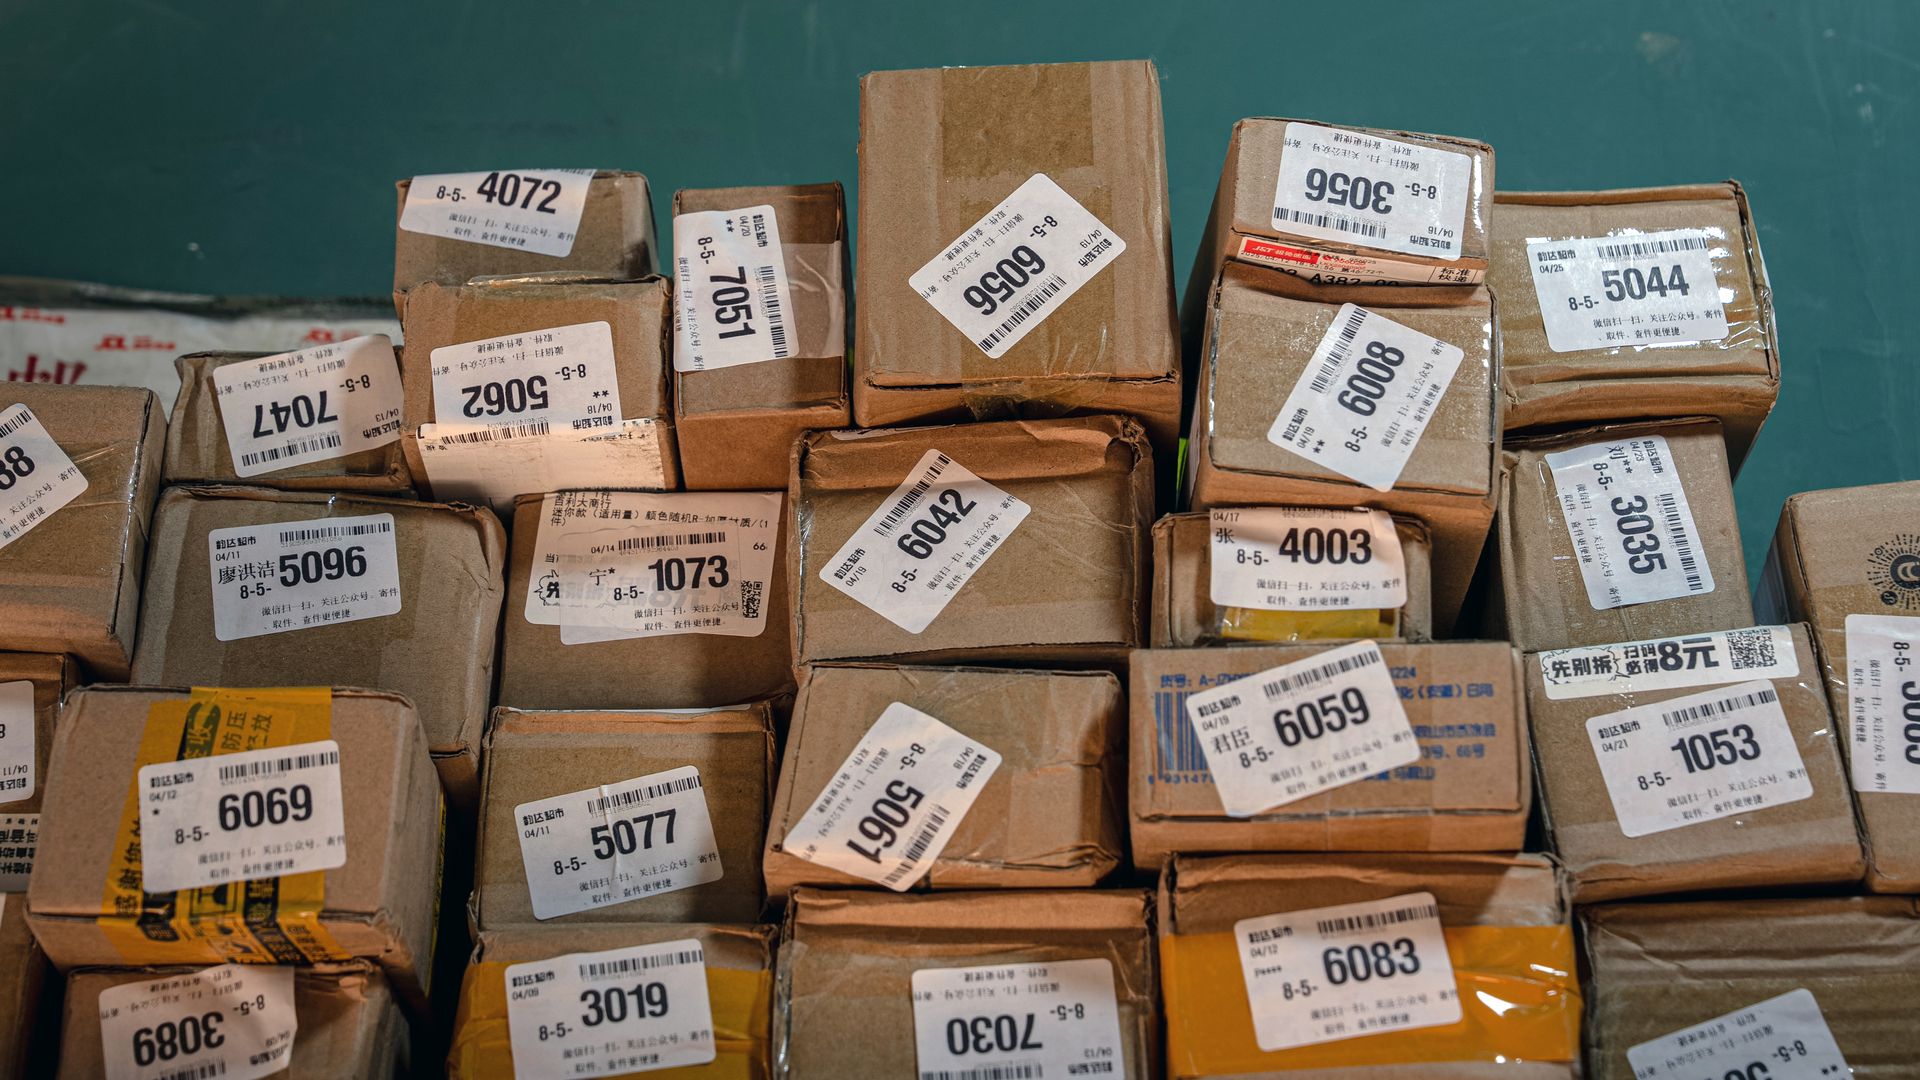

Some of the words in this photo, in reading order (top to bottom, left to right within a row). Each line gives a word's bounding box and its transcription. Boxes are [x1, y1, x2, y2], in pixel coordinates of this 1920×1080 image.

[476, 169, 567, 213] 4072
[1305, 168, 1394, 214] 3056
[739, 215, 750, 236] 04/20
[752, 214, 767, 247] 韵达超市
[1427, 225, 1453, 238] 04/16
[1079, 229, 1102, 248] 04/19
[1409, 235, 1450, 249] 韵达超市
[1078, 238, 1112, 267] 韵达超市
[1537, 249, 1575, 261] 韵达超市
[1539, 263, 1563, 273] 04/25
[963, 245, 1045, 315] 6056
[1601, 264, 1689, 301] 5044
[709, 266, 755, 339] 7051
[1337, 341, 1404, 416] 6008
[461, 375, 548, 417] 5062
[586, 402, 612, 413] 04/18
[252, 390, 337, 438] 7047
[374, 407, 399, 421] 04/13
[572, 415, 612, 429] 韵达超市
[1282, 408, 1307, 441] 韵达超市
[362, 419, 400, 438] 韵达超市
[1296, 426, 1314, 448] 04/19
[1630, 441, 1644, 461] 04/23
[1642, 439, 1663, 473] 韵达超市
[897, 485, 976, 559] 6042
[1213, 512, 1239, 522] 04/17
[215, 536, 256, 549] 韵达超市
[1215, 527, 1234, 543] 张
[1278, 527, 1371, 564] 4003
[1610, 495, 1666, 574] 3035
[215, 551, 239, 561] 04/11
[591, 544, 614, 554] 04/14
[218, 561, 274, 584] 廖洪洁
[279, 546, 366, 587] 5096
[648, 554, 729, 591] 1073
[833, 547, 865, 579] 韵达超市
[845, 565, 866, 586] 04/19
[1623, 643, 1656, 659] 扫码
[1657, 636, 1719, 671] 8元
[1551, 654, 1612, 678] 先别拆
[1625, 658, 1658, 675] 必得
[1201, 714, 1229, 731] 04/19
[1273, 687, 1369, 746] 6059
[1598, 720, 1640, 738] 韵达超市
[1601, 738, 1628, 752] 04/21
[1671, 724, 1760, 773] 1053
[952, 746, 974, 769] 04/18
[3, 764, 28, 776] 04/11
[149, 789, 176, 801] 04/12
[218, 784, 312, 831] 6069
[522, 808, 564, 825] 韵达超市
[524, 825, 549, 838] 04/11
[846, 779, 924, 863] 5061
[590, 808, 676, 859] 5077
[1322, 937, 1419, 985] 6083
[580, 981, 668, 1026] 3019
[132, 1011, 224, 1066] 3089
[946, 1013, 1042, 1055] 7030
